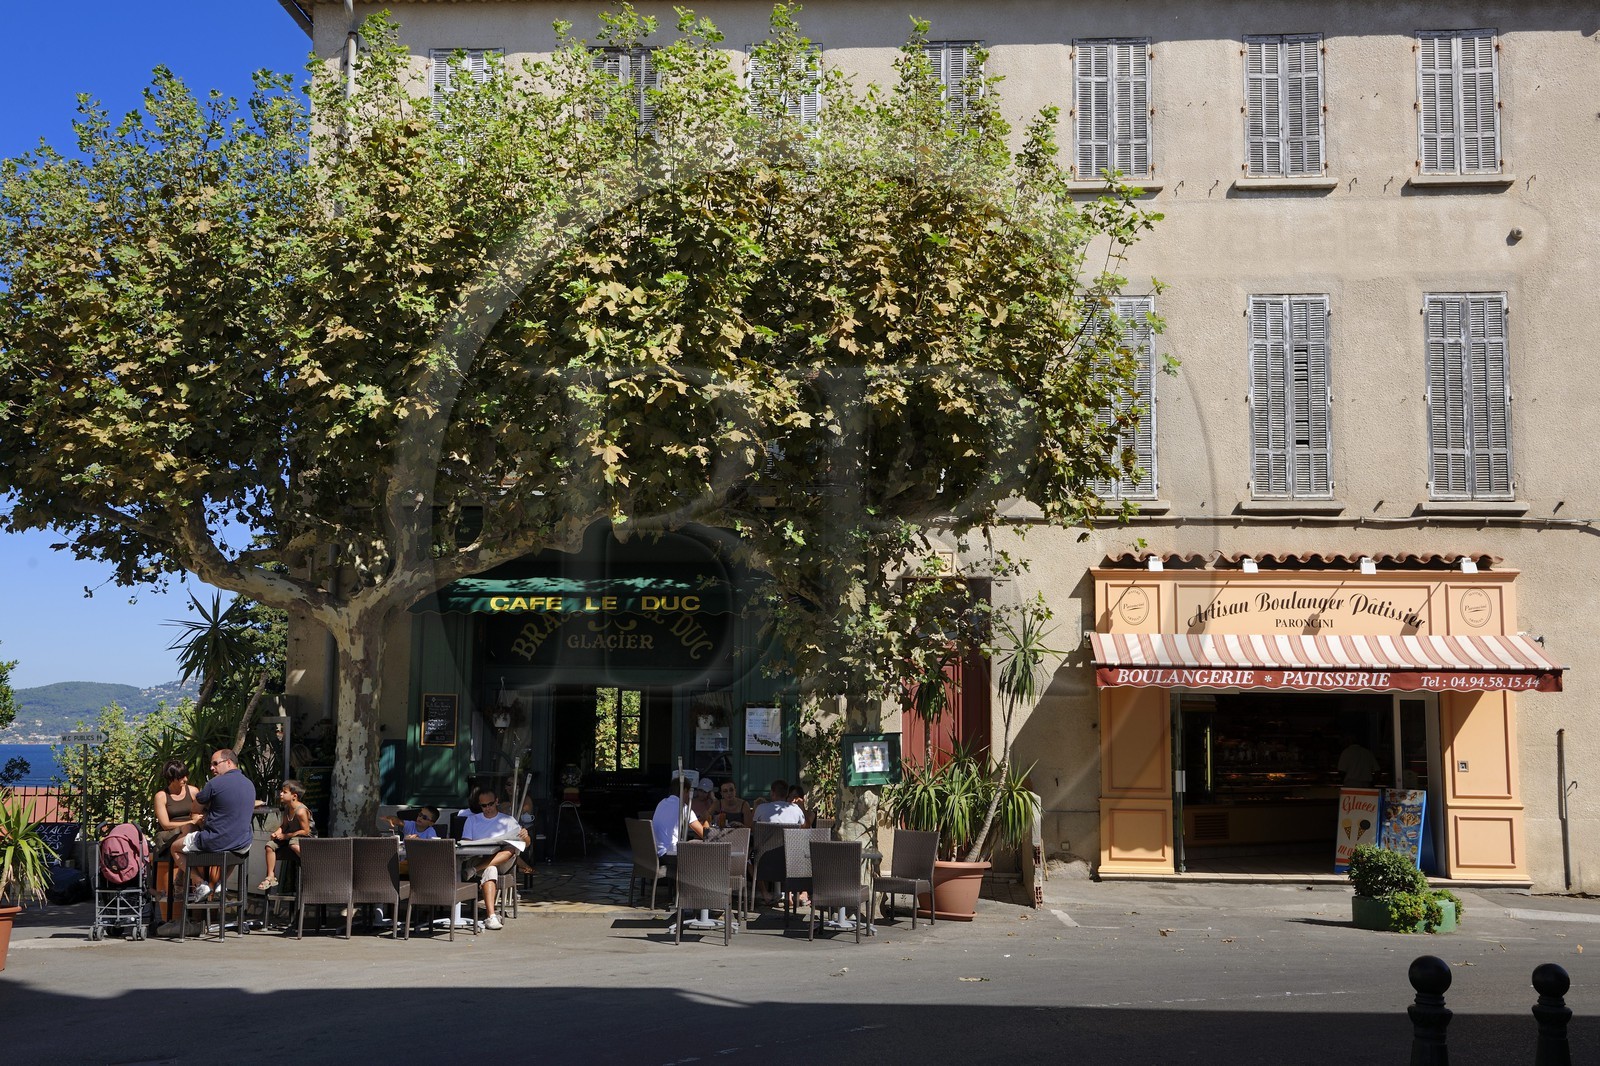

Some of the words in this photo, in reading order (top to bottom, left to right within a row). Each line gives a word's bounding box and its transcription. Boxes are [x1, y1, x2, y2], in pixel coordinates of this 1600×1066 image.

[489, 596, 563, 611] CAFE
[585, 596, 618, 611] LE
[641, 596, 701, 611] DUC
[1187, 599, 1249, 628] Artisan
[1254, 590, 1345, 613] Boulanger
[1349, 592, 1426, 629] Pâtissier
[1275, 618, 1334, 629] PARONCINI
[1116, 669, 1255, 685] BOULANGERIE
[1280, 671, 1391, 687] PATISSERIE
[1420, 676, 1440, 688] Tel
[1450, 676, 1541, 689] 04.94.58.15.44
[1342, 795, 1376, 814] Glaces
[35, 824, 73, 834] PLACE
